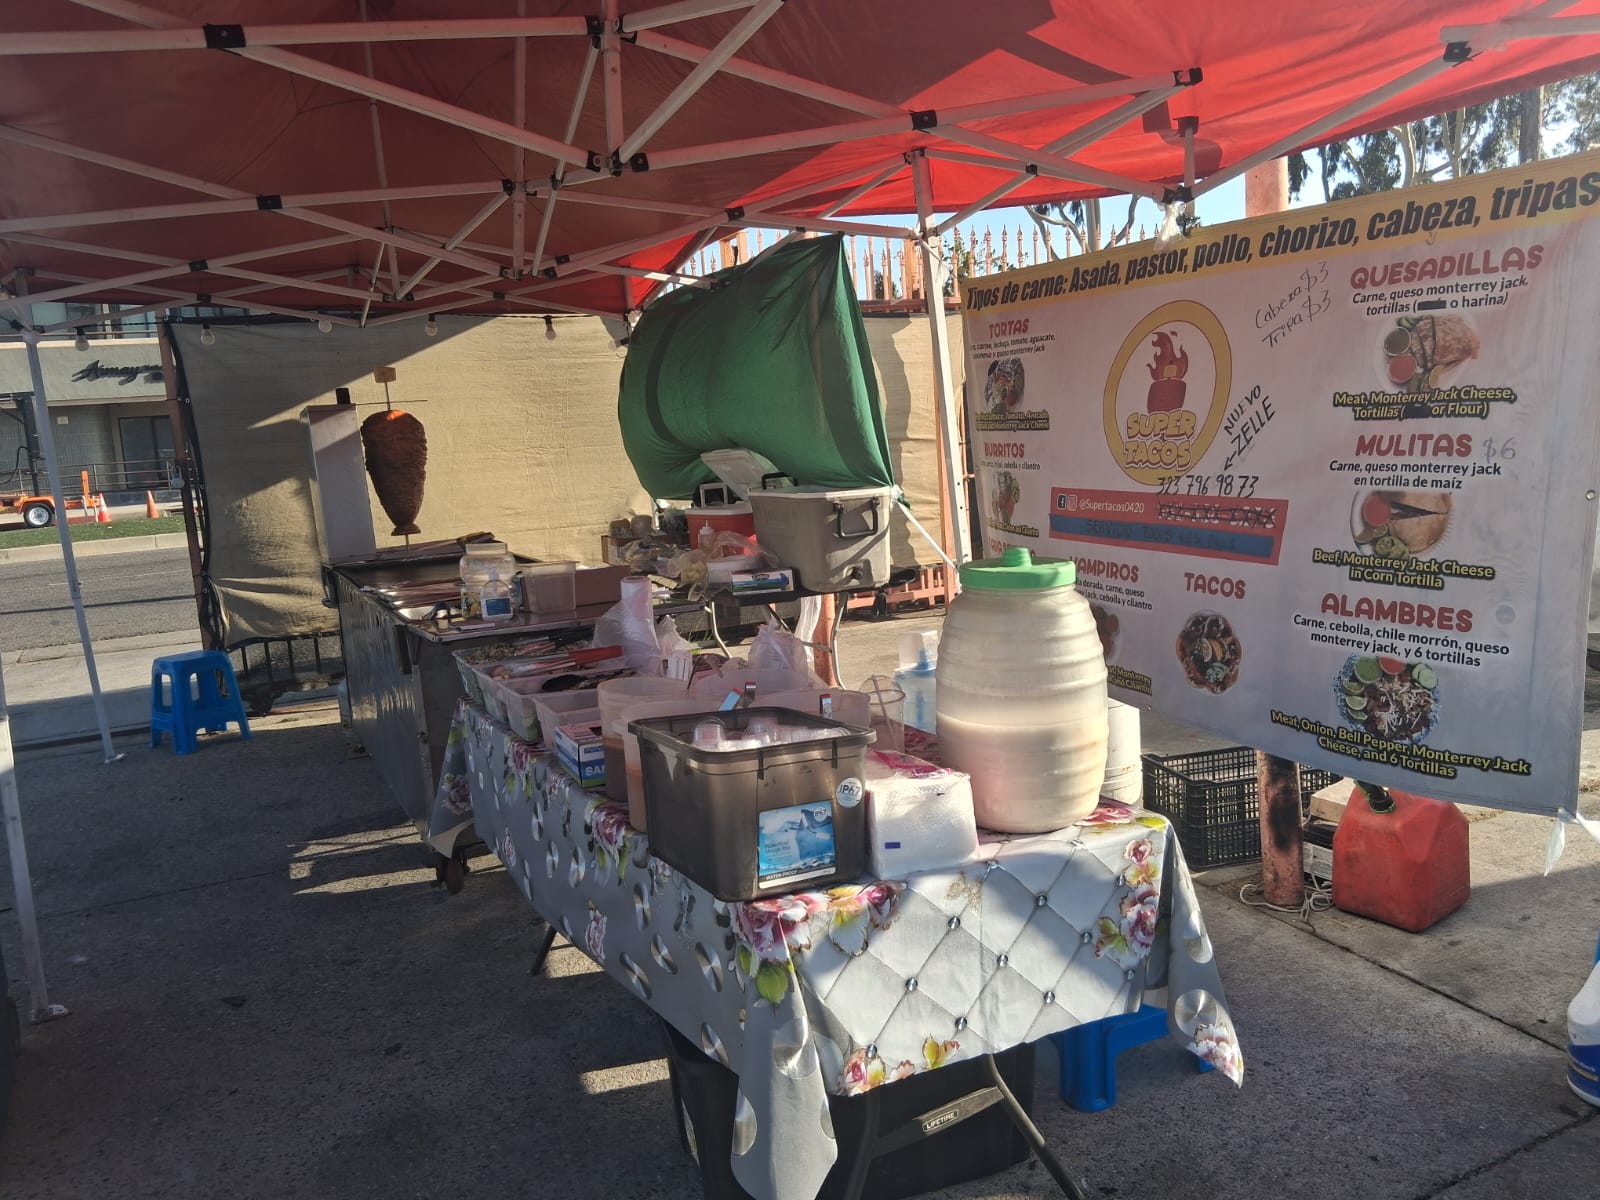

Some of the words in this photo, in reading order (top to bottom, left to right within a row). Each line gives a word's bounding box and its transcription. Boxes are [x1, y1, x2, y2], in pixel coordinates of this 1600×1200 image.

[967, 286, 999, 311] Tipos
[1001, 280, 1020, 303] de
[1021, 275, 1068, 300] carne:
[1069, 266, 1121, 292] Asada,
[1125, 247, 1189, 285] pastor,
[1192, 233, 1253, 273] pollo,
[1259, 216, 1359, 258] chorizo,
[1366, 195, 1480, 241] cabeza,
[1489, 171, 1600, 220] tripas
[1350, 244, 1545, 290] QUESADILLAS
[1255, 285, 1302, 329] Cabeza
[1300, 261, 1330, 292] $3
[1352, 291, 1387, 305] Carne,
[1390, 287, 1424, 303] queso
[1426, 280, 1498, 300] monterrey
[1498, 275, 1529, 294] jack,
[1366, 301, 1411, 317] tortillas
[1449, 298, 1458, 309] o
[1461, 291, 1508, 308] harina)
[989, 318, 1030, 338] TORTAS
[1262, 312, 1304, 349] Tripa
[1302, 289, 1332, 322] $3
[1223, 384, 1261, 436] NUEVO
[1335, 392, 1369, 407] Meat,
[1371, 389, 1431, 406] Monterrey
[1432, 387, 1458, 402] Jack
[1460, 386, 1515, 401] Cheese,
[1354, 405, 1399, 418] Tortillas
[1432, 405, 1445, 415] or
[1447, 402, 1488, 417] Flour)
[1126, 411, 1197, 440] SUPER
[1230, 395, 1276, 457] ZELLE
[984, 442, 1024, 458] BURRITOS
[1124, 440, 1191, 470] TACOS
[1355, 434, 1472, 457] MULITAS
[1483, 436, 1516, 462] $6
[1329, 460, 1362, 474] Carne,
[1365, 462, 1398, 474] queso
[1401, 462, 1469, 476] monterrey
[1471, 462, 1501, 476] jack
[1354, 476, 1368, 485] en
[1370, 474, 1410, 488] tortilla
[1413, 475, 1428, 488] de
[1431, 476, 1462, 489] maíz
[1156, 475, 1180, 496] 323
[1186, 475, 1209, 497] 796
[1215, 474, 1233, 497] 98
[1237, 475, 1259, 499] 73
[1078, 499, 1145, 513] @Supertacos0420
[1314, 549, 1342, 563] Beef,
[1343, 552, 1407, 571] Monterrey
[1410, 558, 1438, 573] Jack
[1442, 561, 1494, 577] Cheese
[1184, 572, 1247, 600] TACOS
[1351, 567, 1362, 578] in
[1364, 569, 1393, 583] Corn
[1397, 571, 1443, 588] Tortilla
[1099, 592, 1121, 605] cebolla
[1127, 600, 1153, 611] cilantro
[1125, 588, 1145, 598] queso
[1321, 592, 1474, 632] ALAMBRES
[1293, 614, 1328, 630] Carne,
[1329, 620, 1374, 639] cebolla,
[1375, 626, 1406, 641] chile
[1408, 631, 1462, 652] morrón,
[1465, 640, 1510, 656] queso
[1310, 631, 1370, 652] monterrey
[1371, 639, 1401, 657] jack,
[1404, 648, 1413, 659] y
[1414, 646, 1423, 658] 6
[1425, 648, 1481, 667] tortillas
[1271, 710, 1300, 728] Meat,
[1301, 719, 1337, 738] Onion,
[1338, 728, 1362, 743] Bell
[1363, 732, 1411, 754] Pepper,
[1412, 745, 1491, 769] Monterrey
[1493, 757, 1530, 774] Jack
[1318, 735, 1362, 758] Cheese,
[1363, 747, 1387, 763] and
[1389, 752, 1398, 764] 6
[1400, 754, 1455, 777] Tortillas
[839, 785, 860, 796] IP67
[926, 1112, 955, 1129] LIFETIME
